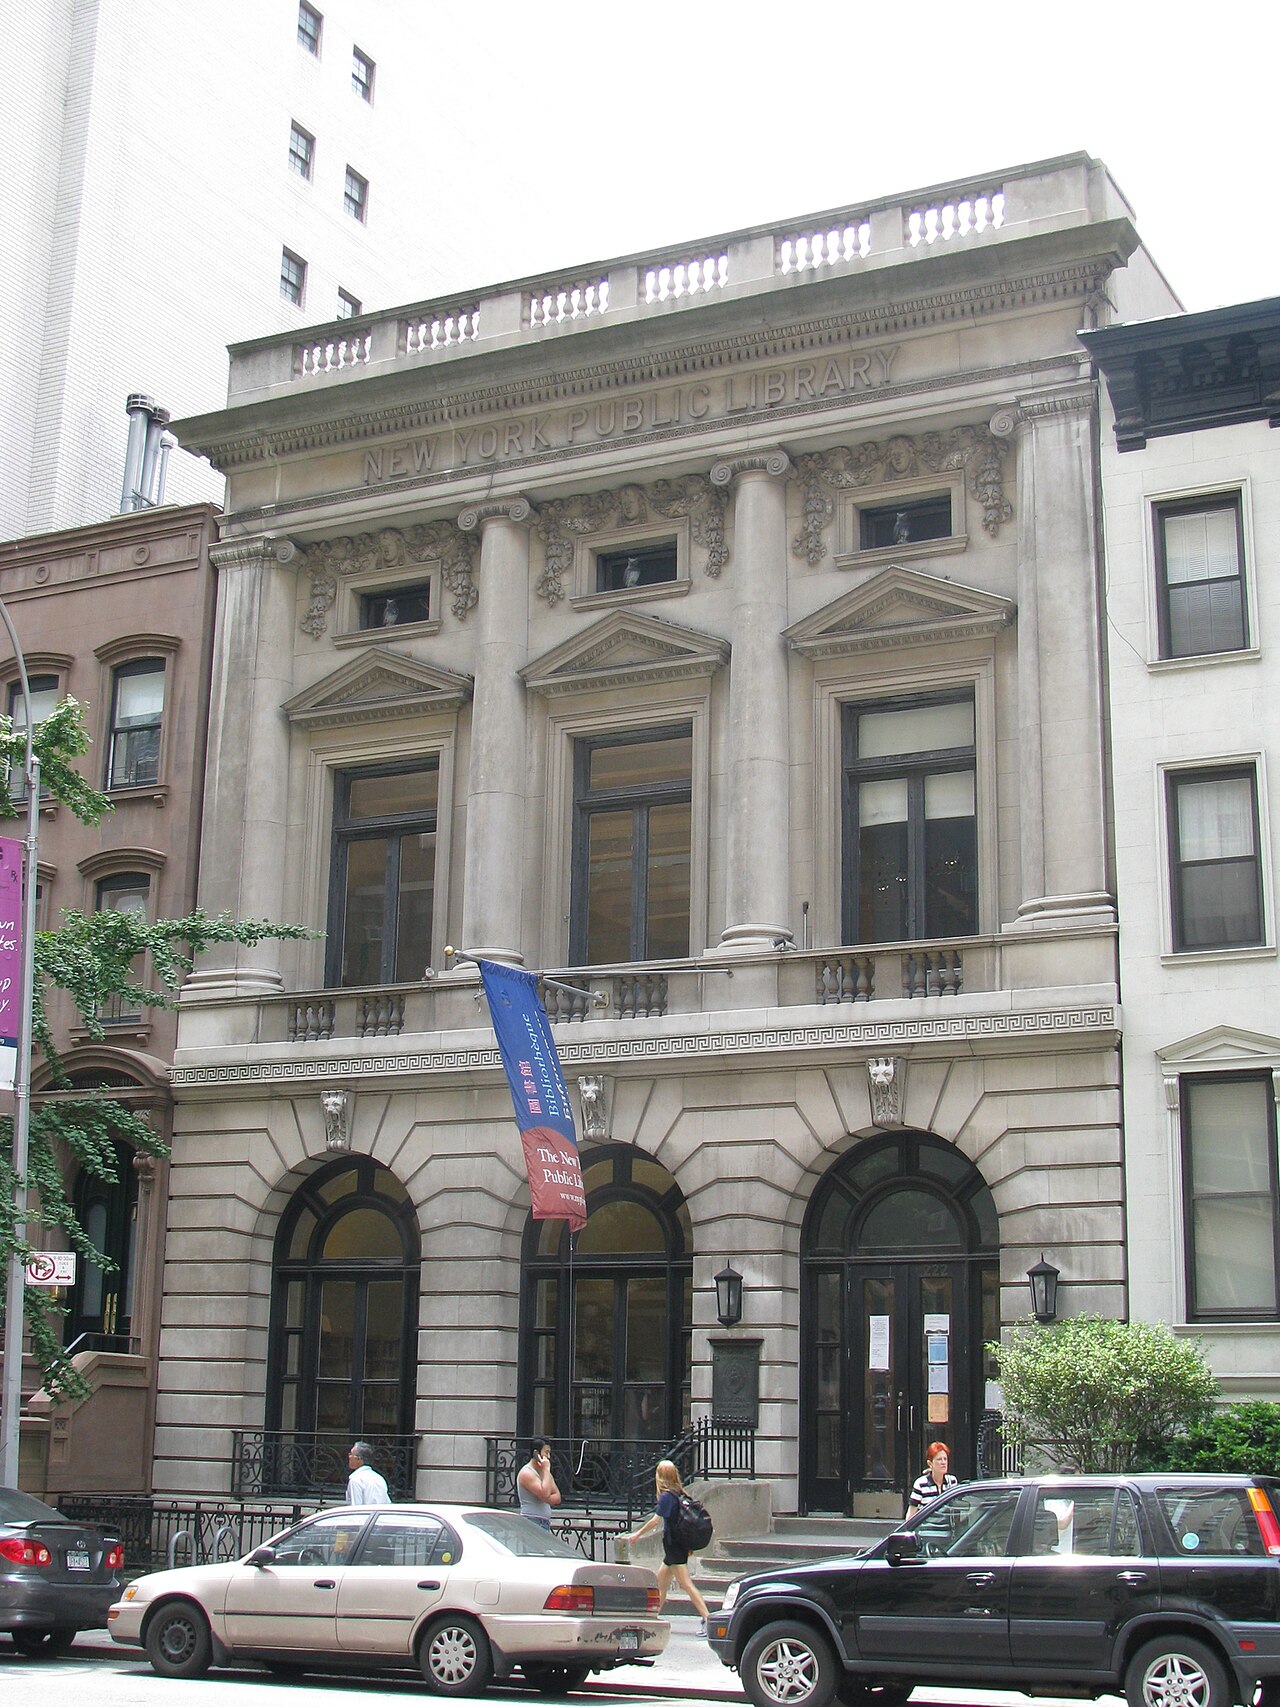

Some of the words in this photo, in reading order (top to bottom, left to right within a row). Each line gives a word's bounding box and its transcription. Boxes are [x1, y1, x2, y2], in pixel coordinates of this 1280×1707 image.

[362, 434, 439, 484] NEW
[453, 412, 553, 464] YORK
[564, 382, 711, 444] PUBLIC
[723, 345, 902, 414] LIBRARY
[537, 1147, 559, 1164] The
[559, 1150, 577, 1167] New
[542, 1168, 574, 1186] Public
